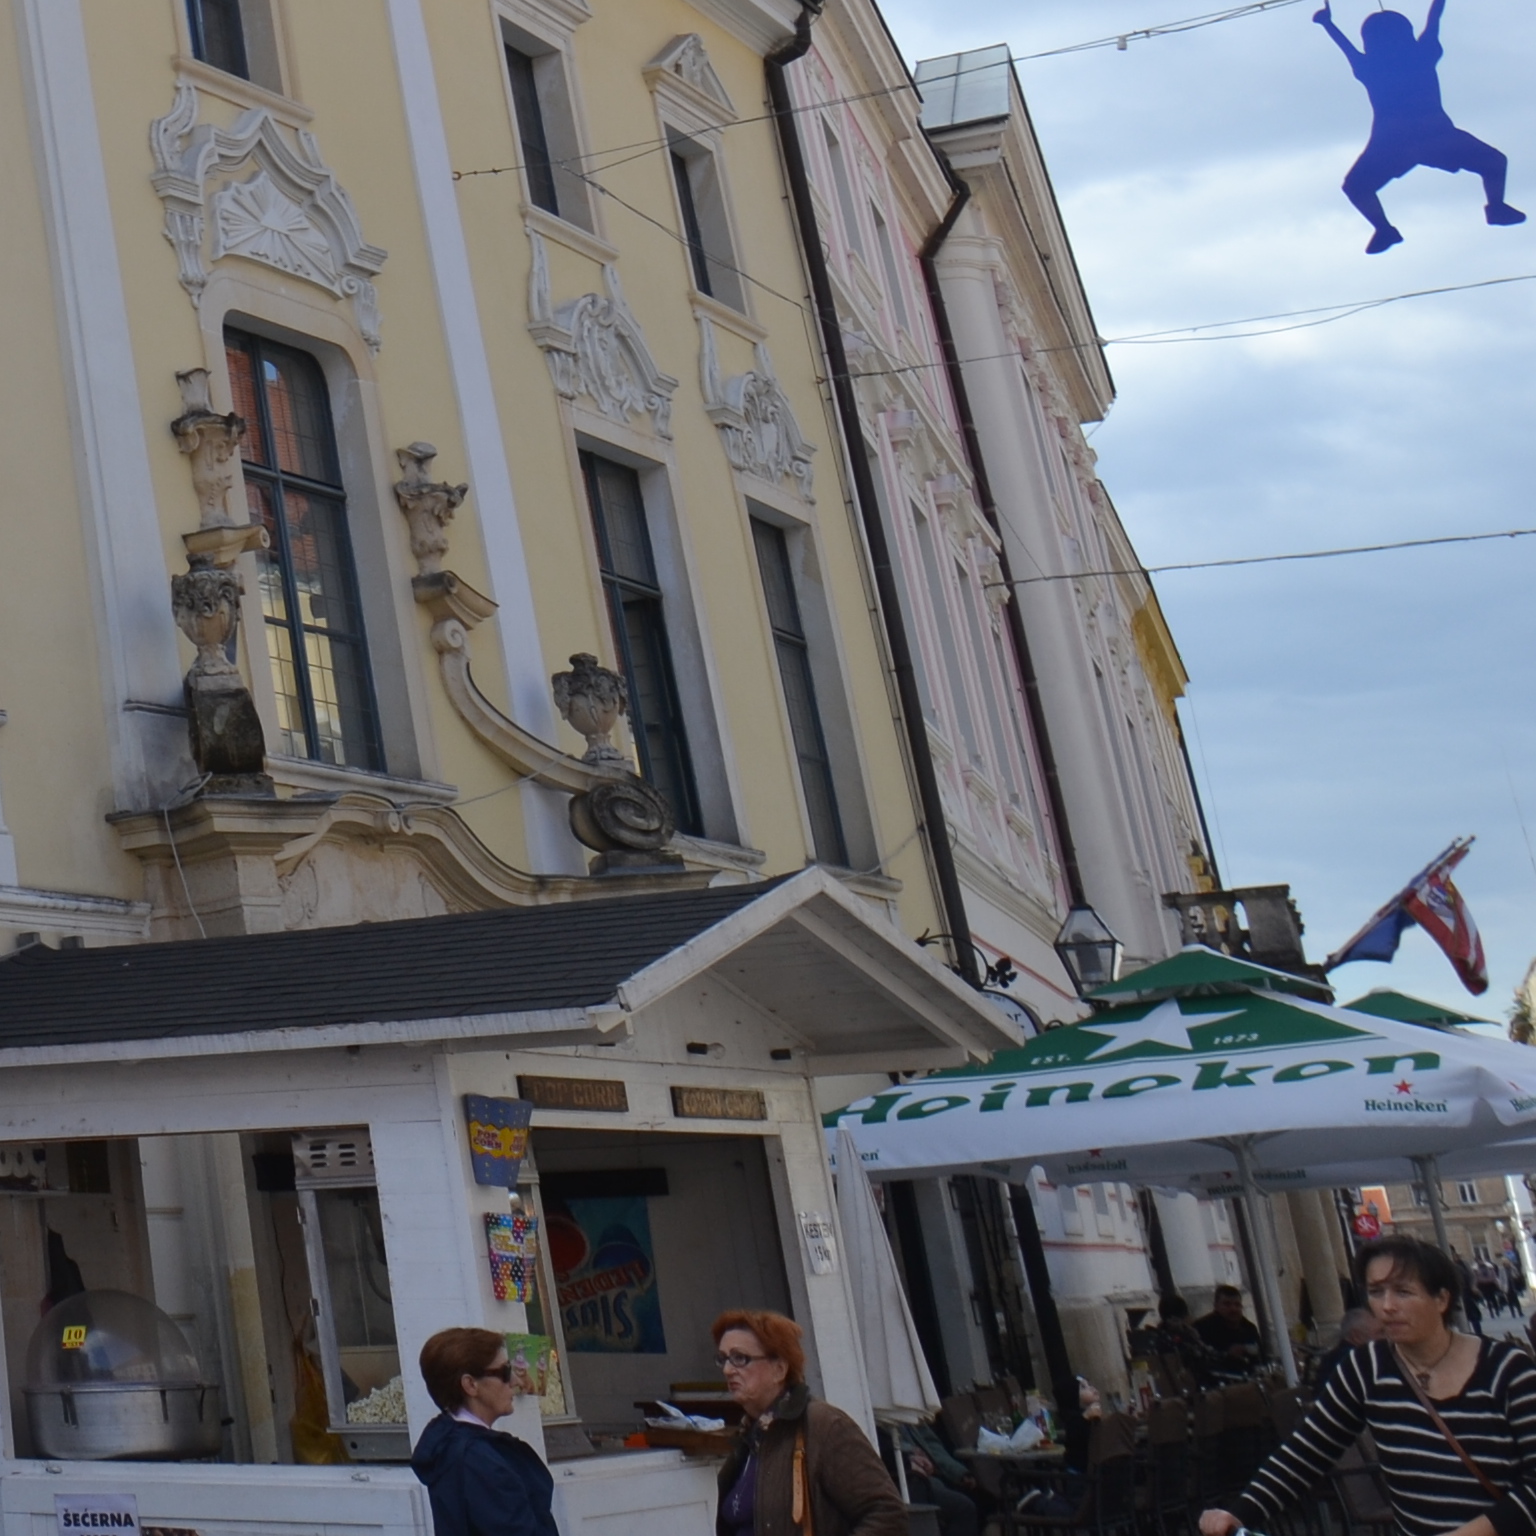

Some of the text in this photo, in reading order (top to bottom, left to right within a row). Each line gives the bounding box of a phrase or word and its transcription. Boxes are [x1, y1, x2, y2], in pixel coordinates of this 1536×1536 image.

[1213, 1032, 1260, 1045] 1873
[1030, 1053, 1071, 1066] EST.
[534, 1081, 620, 1108] POP CORN
[1364, 1099, 1449, 1113] Heineken
[477, 1129, 498, 1140] POP
[473, 1136, 502, 1151] CORN
[557, 1260, 646, 1307] LEDEN
[562, 1290, 634, 1340] Slus
[66, 1328, 84, 1342] 10
[63, 1507, 136, 1528] ŠEĆERNA
